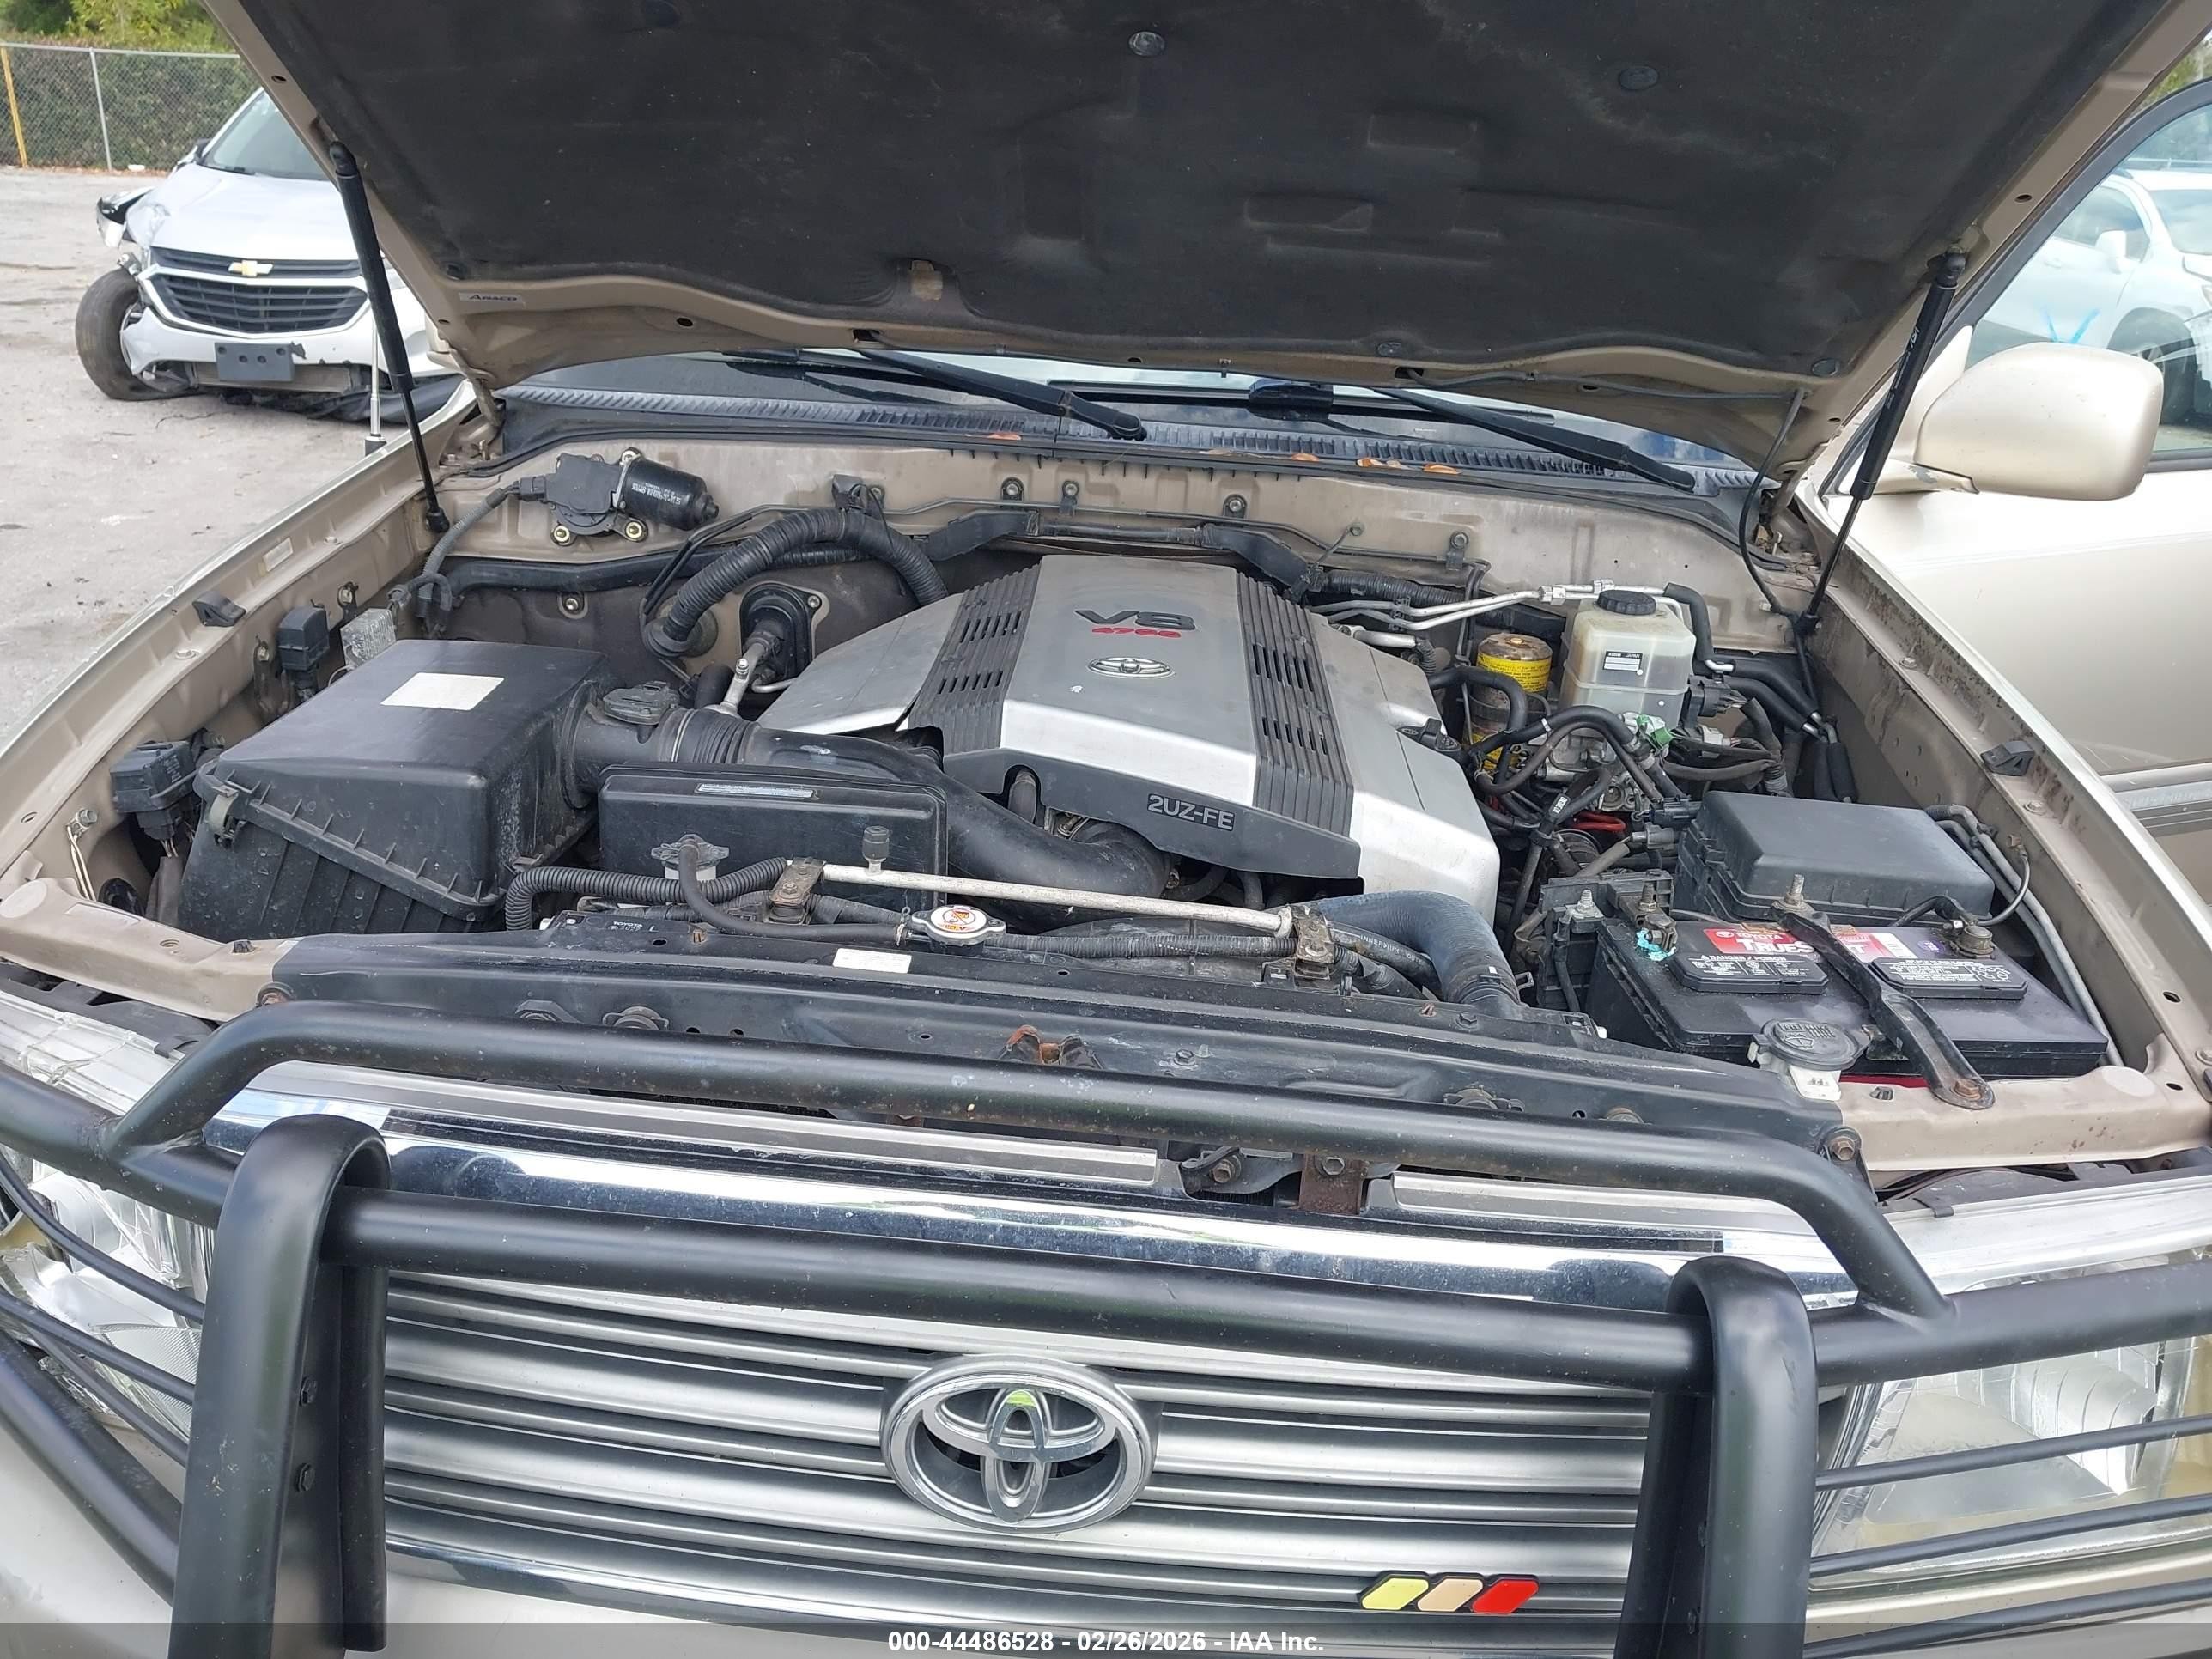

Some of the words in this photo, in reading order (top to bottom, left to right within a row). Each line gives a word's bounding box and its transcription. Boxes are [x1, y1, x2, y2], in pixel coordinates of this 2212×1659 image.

[1074, 610, 1196, 630] V8
[1147, 794, 1235, 831] 2UZ-FE
[1734, 932, 1784, 940] TOYOTA
